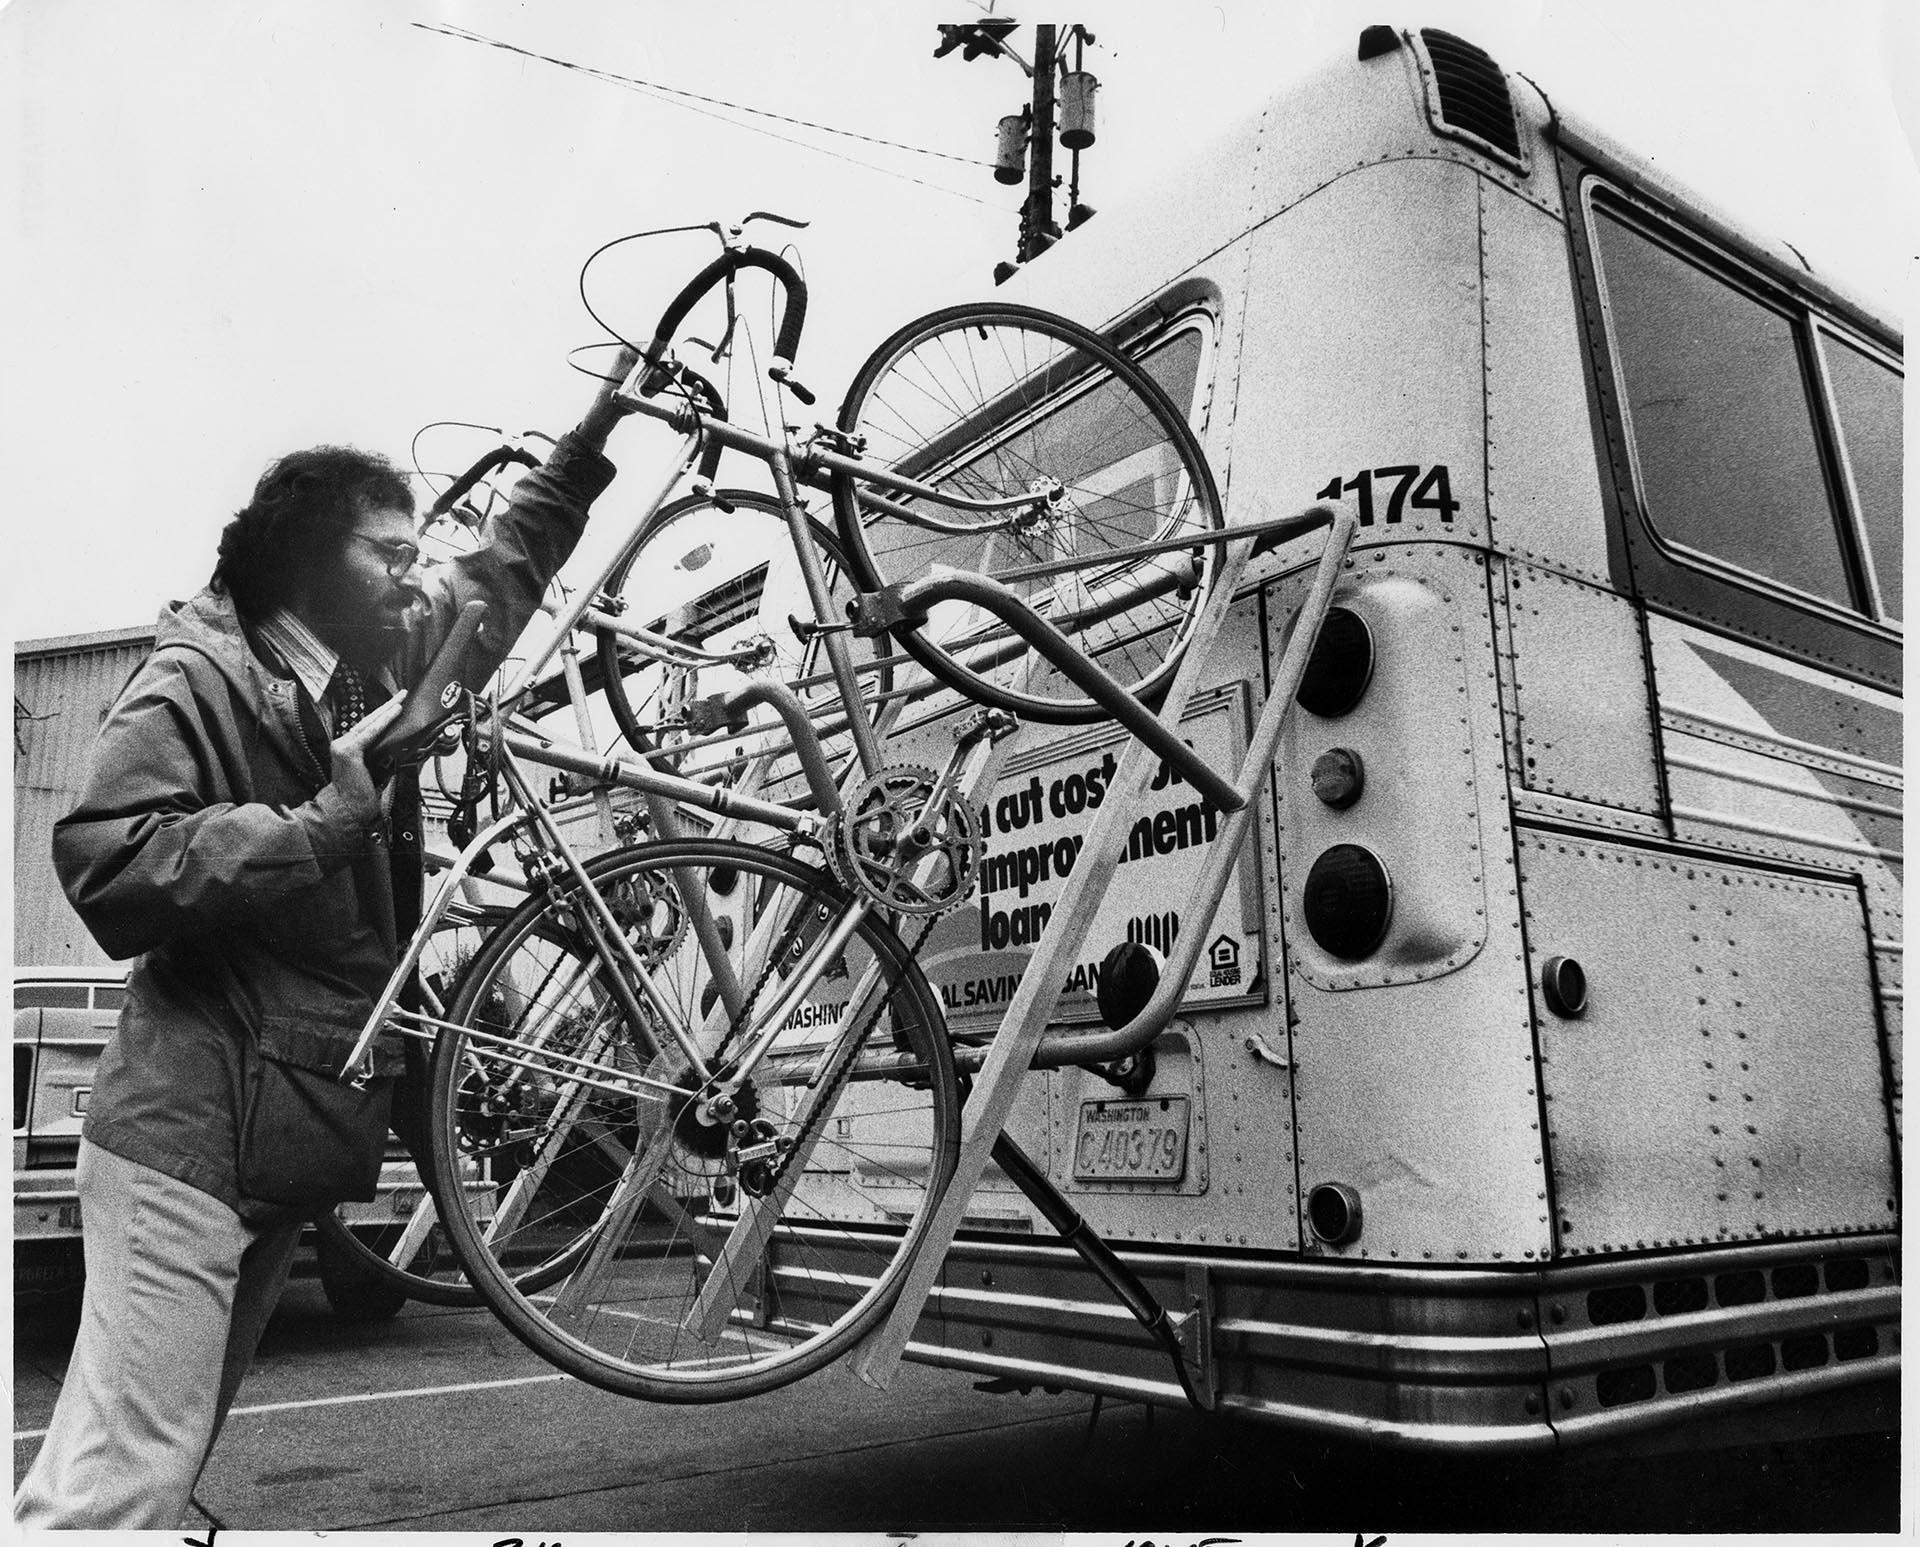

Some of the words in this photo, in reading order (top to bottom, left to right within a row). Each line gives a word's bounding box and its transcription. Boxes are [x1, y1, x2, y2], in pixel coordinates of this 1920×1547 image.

[996, 776, 1044, 834] cut
[979, 802, 1218, 899] improment
[980, 895, 1058, 952] loan
[1209, 974, 1241, 988] LENDER
[1086, 1106, 1151, 1123] WASHINGTON
